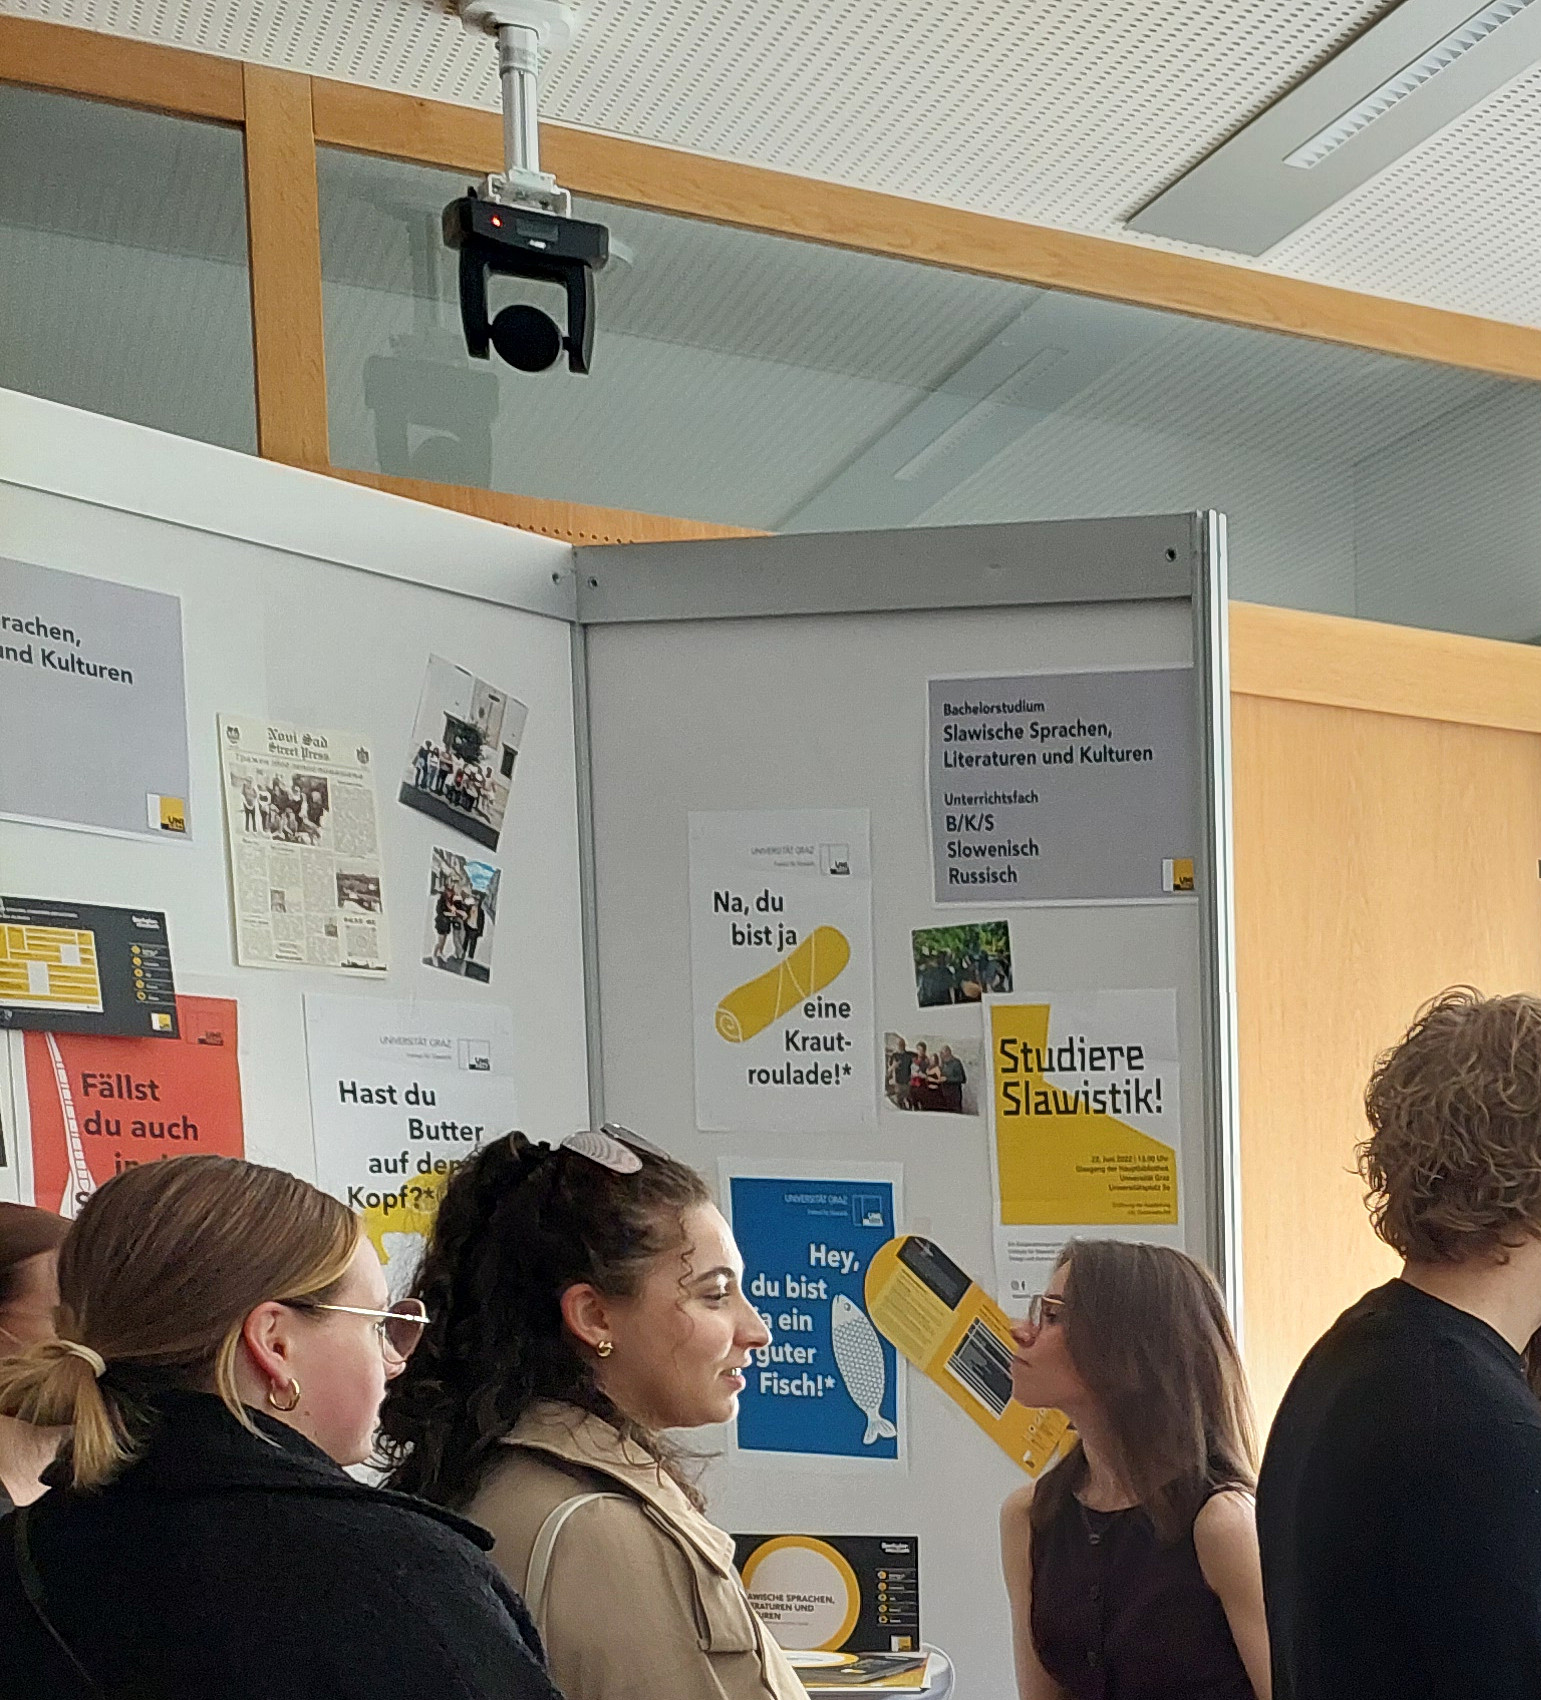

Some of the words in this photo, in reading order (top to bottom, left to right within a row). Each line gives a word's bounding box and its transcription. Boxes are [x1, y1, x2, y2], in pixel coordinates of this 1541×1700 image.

[41, 648, 134, 685] Kulturen
[944, 700, 1045, 716] Bachelorstudium
[943, 721, 1024, 743] Slawische
[1029, 718, 1112, 743] Sprachen,
[944, 750, 1036, 768] Literaturen
[1043, 745, 1074, 765] und
[1080, 744, 1153, 764] Kulturen
[944, 790, 1039, 806] Unterrichtsfach
[946, 813, 994, 832] B/K/S
[947, 838, 1039, 858] Slowenisch
[949, 865, 1018, 884] Russisch
[713, 890, 749, 915] Na,
[756, 889, 784, 912] du
[731, 922, 772, 946] bist
[777, 922, 798, 953] ja
[803, 995, 851, 1018] eine
[785, 1029, 852, 1052] Kraut-
[1000, 1036, 1145, 1074] Studiere
[81, 1071, 161, 1101] Fällst
[338, 1080, 397, 1105] Hast
[404, 1082, 436, 1106] du
[1002, 1078, 1163, 1116] Slawistik!
[83, 1110, 121, 1136] du
[131, 1115, 199, 1141] auch
[408, 1118, 484, 1142] Butter
[368, 1150, 409, 1174] auf
[809, 1243, 860, 1274] Hey,
[750, 1273, 780, 1297] du
[785, 1274, 828, 1300] bist
[778, 1307, 814, 1332] ein
[755, 1343, 817, 1368] guter
[794, 1603, 815, 1612] UND
